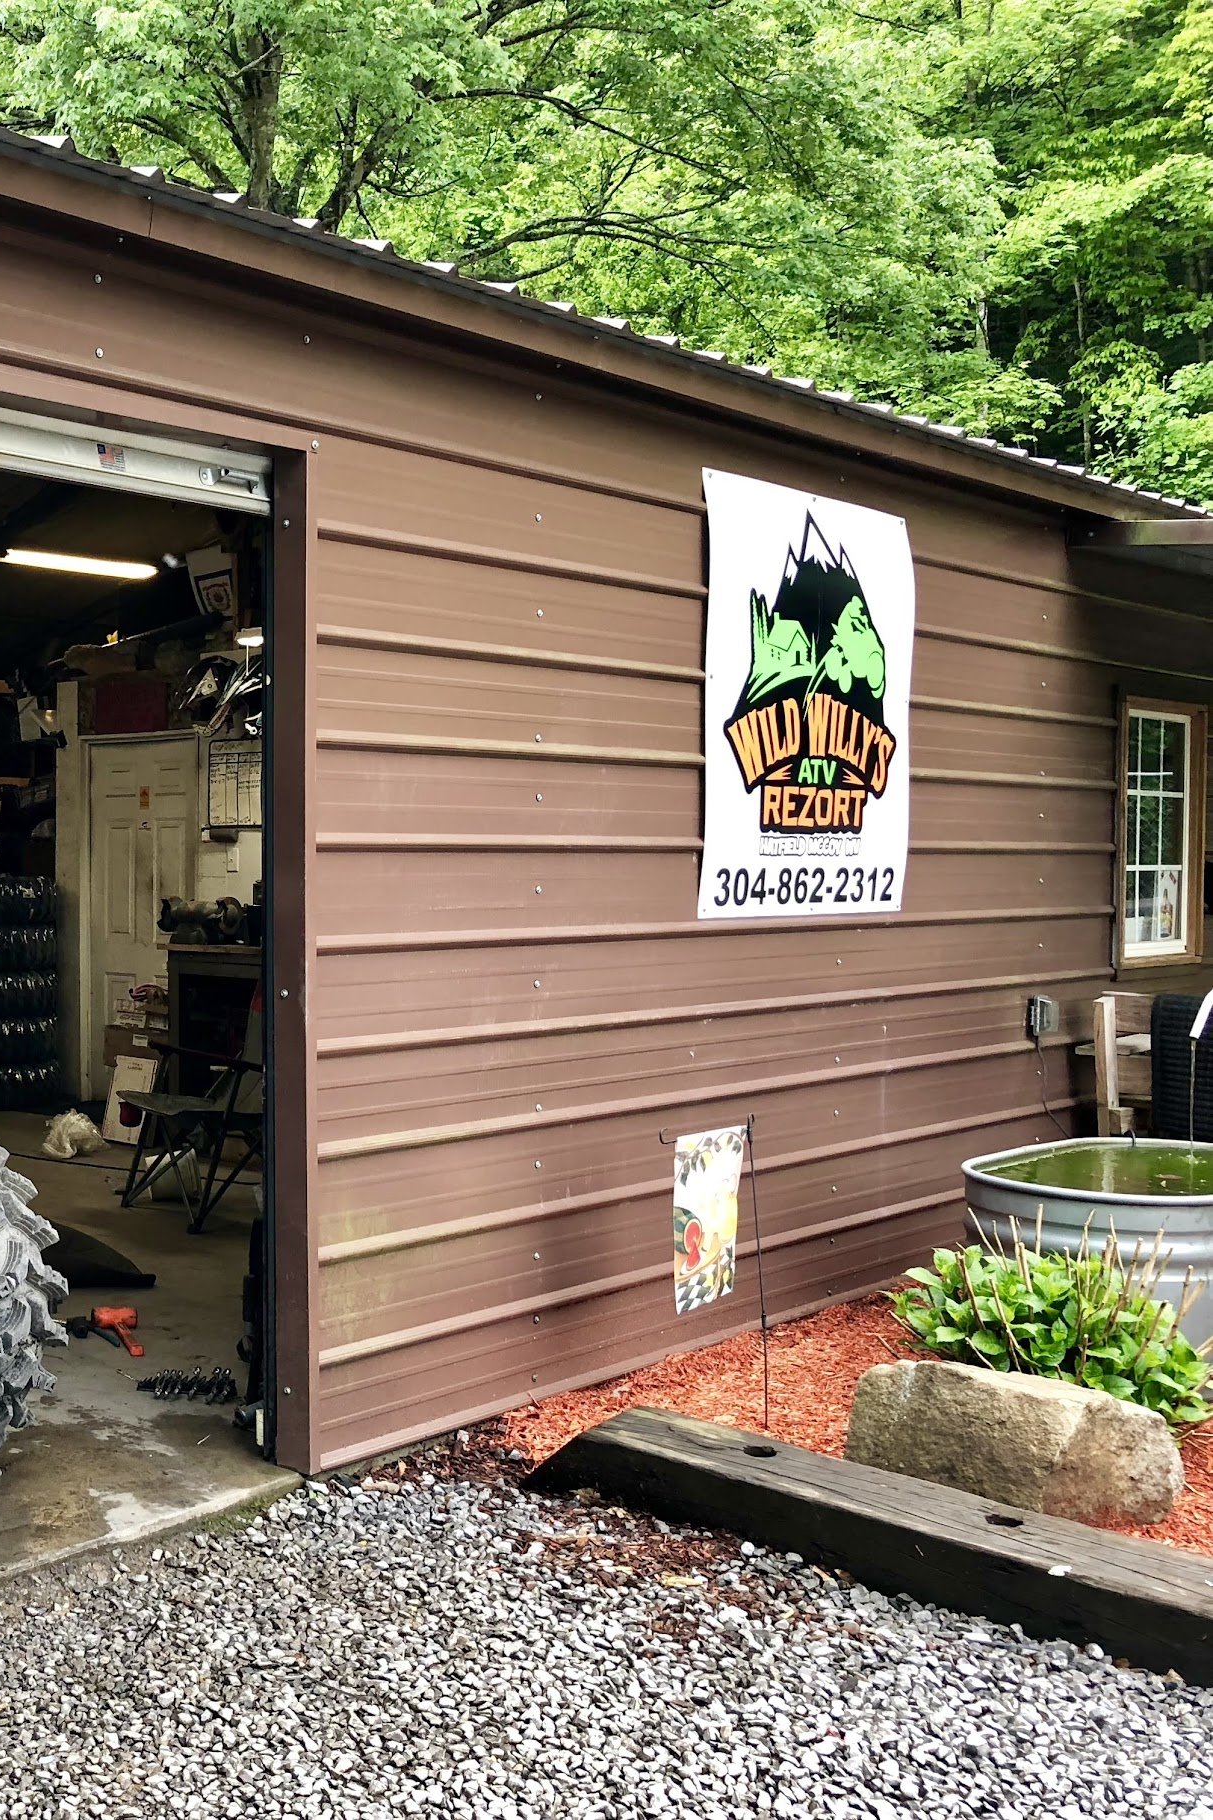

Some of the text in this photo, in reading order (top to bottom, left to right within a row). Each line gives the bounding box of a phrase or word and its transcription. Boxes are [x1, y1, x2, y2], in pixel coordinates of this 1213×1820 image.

[727, 692, 894, 792] WILD WILLY'S
[797, 757, 837, 785] ATV
[763, 785, 866, 828] REZORT
[758, 835, 806, 857] HATFIELD
[713, 866, 895, 907] 304-862-2312
